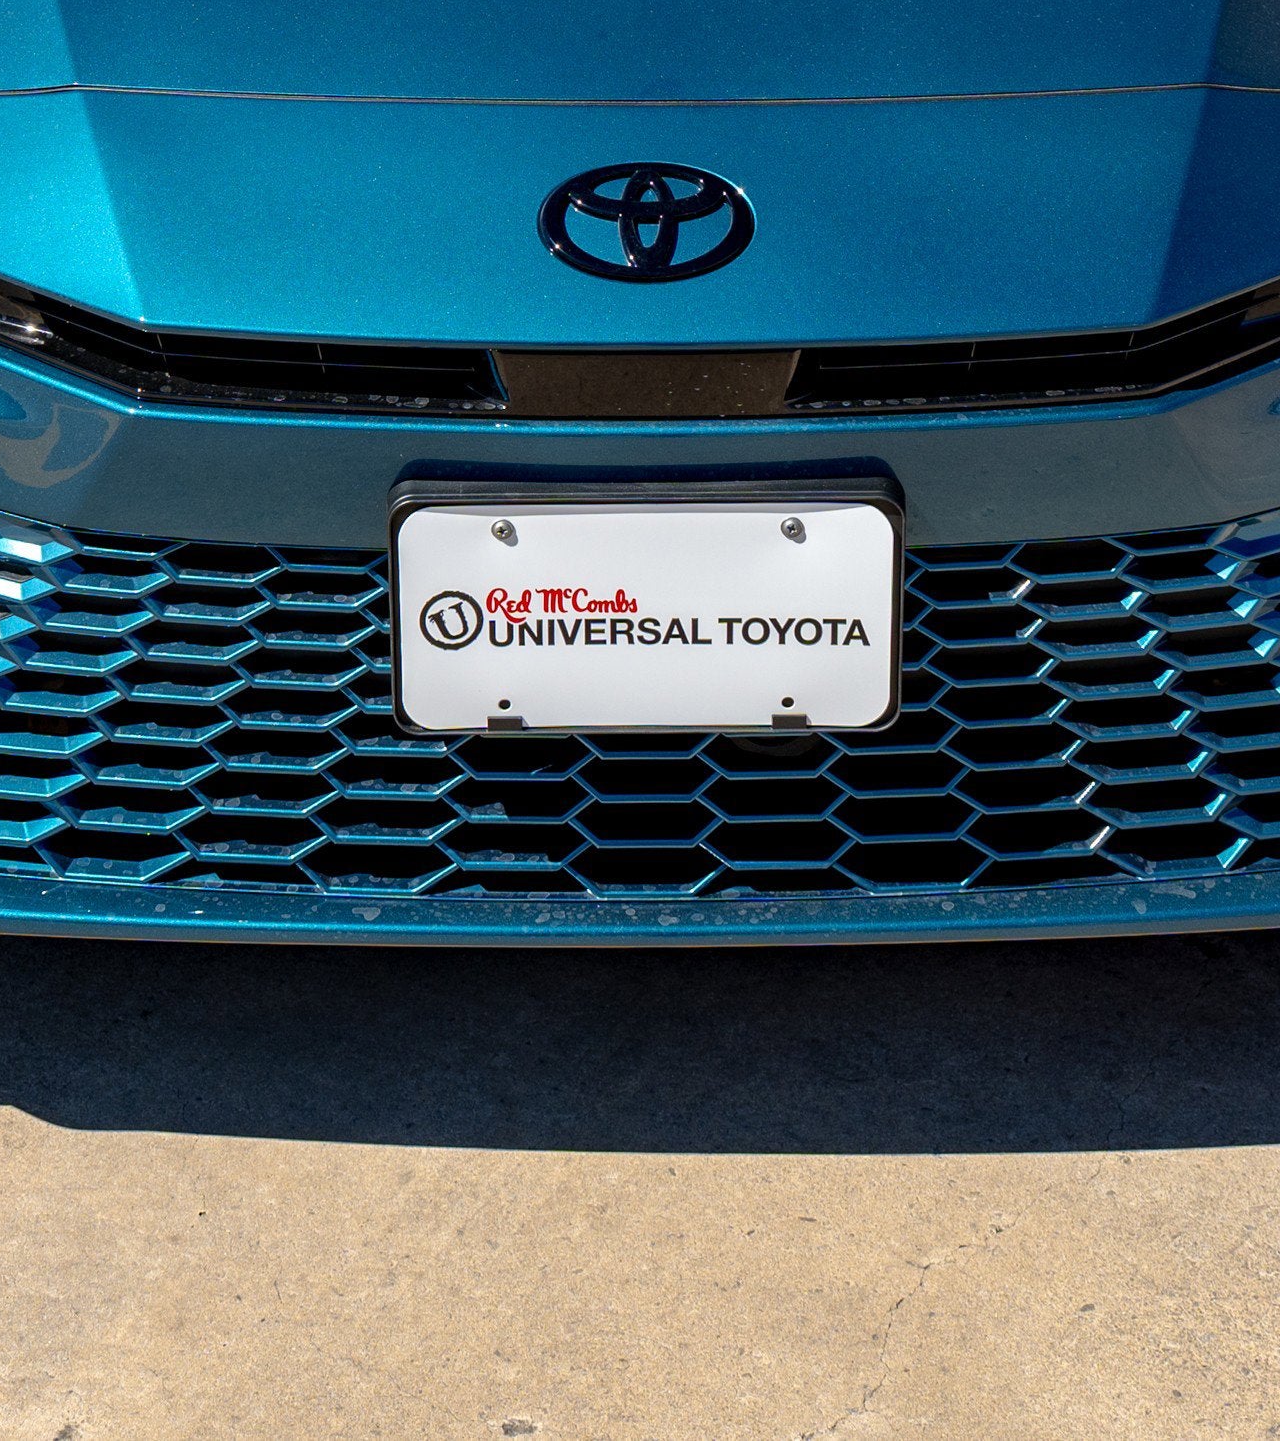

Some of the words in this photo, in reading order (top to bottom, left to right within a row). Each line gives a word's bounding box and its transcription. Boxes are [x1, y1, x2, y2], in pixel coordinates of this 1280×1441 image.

[485, 588, 532, 624] Red
[535, 588, 638, 615] McCombs
[489, 617, 713, 648] UNIVERSAL
[717, 617, 871, 646] TOYOTA
